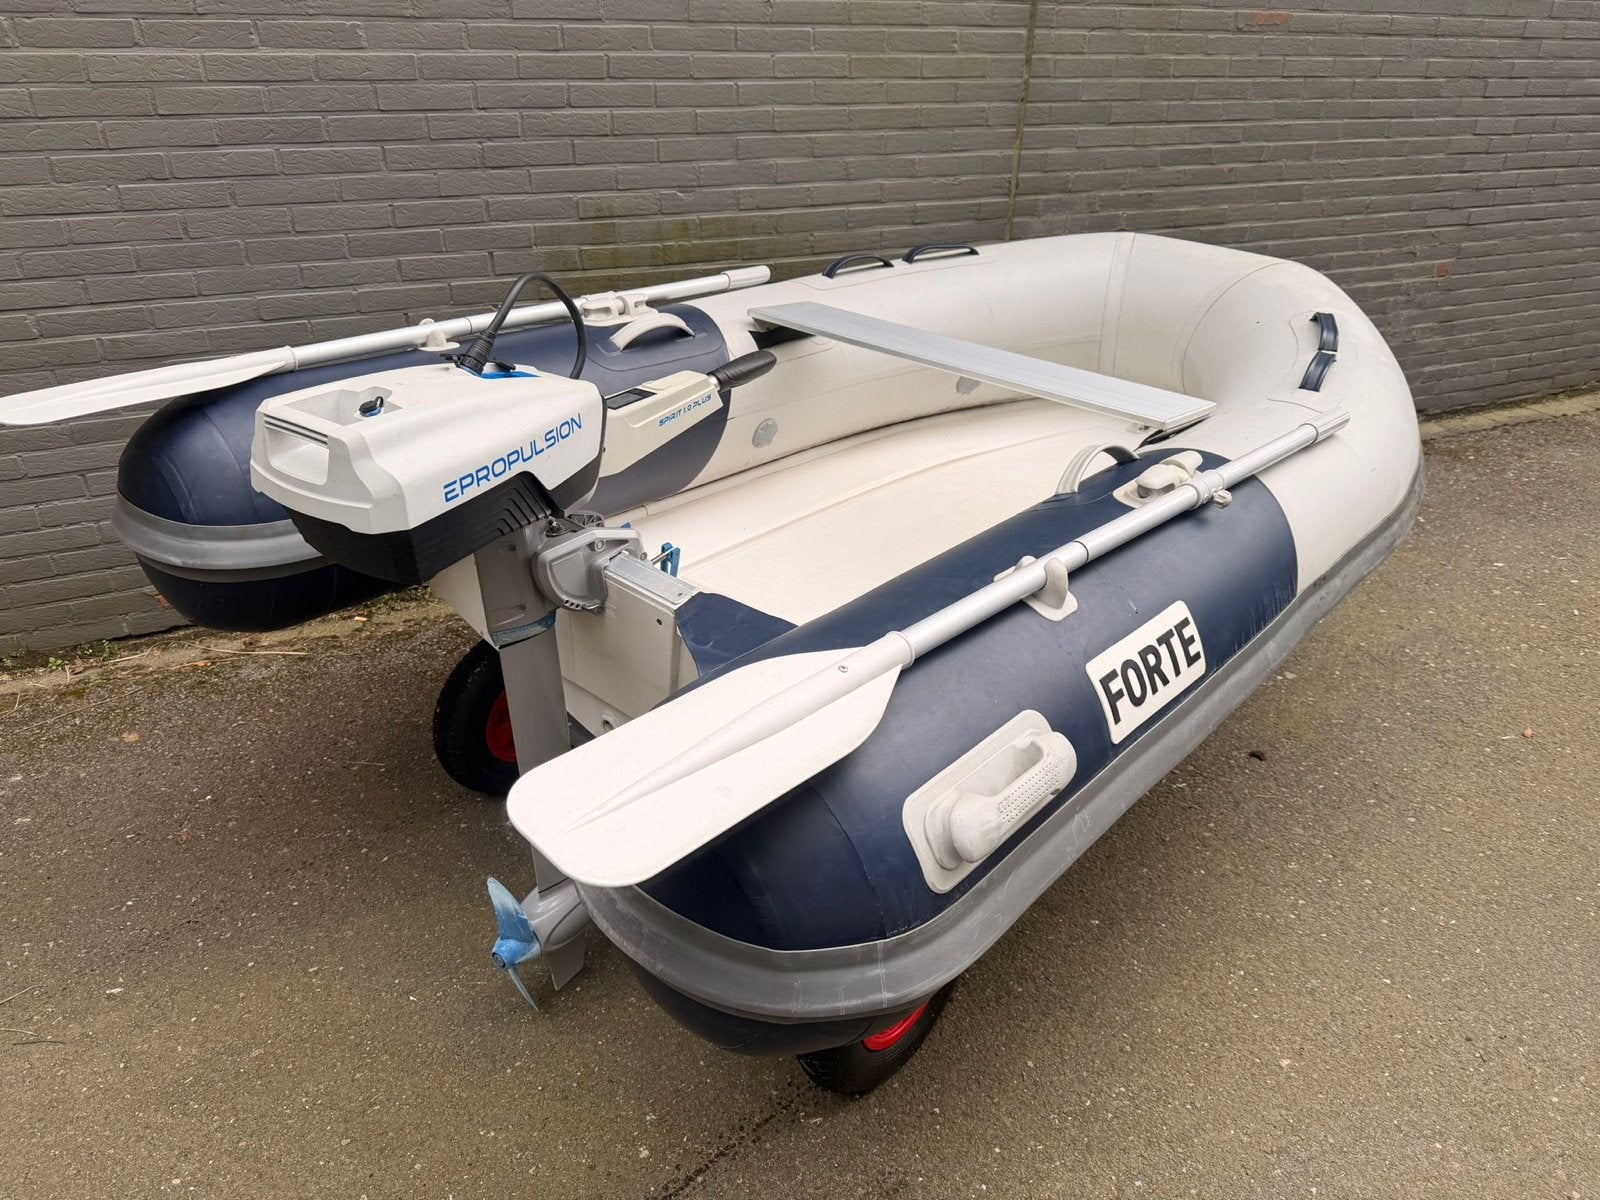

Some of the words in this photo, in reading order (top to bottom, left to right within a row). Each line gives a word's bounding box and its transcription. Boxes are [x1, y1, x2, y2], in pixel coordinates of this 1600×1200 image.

[659, 409, 682, 427] SPIRIT
[683, 404, 692, 414] 1.0
[692, 393, 712, 409] PLUS
[443, 412, 582, 503] EPROPULSION
[1098, 616, 1202, 725] FORTE
